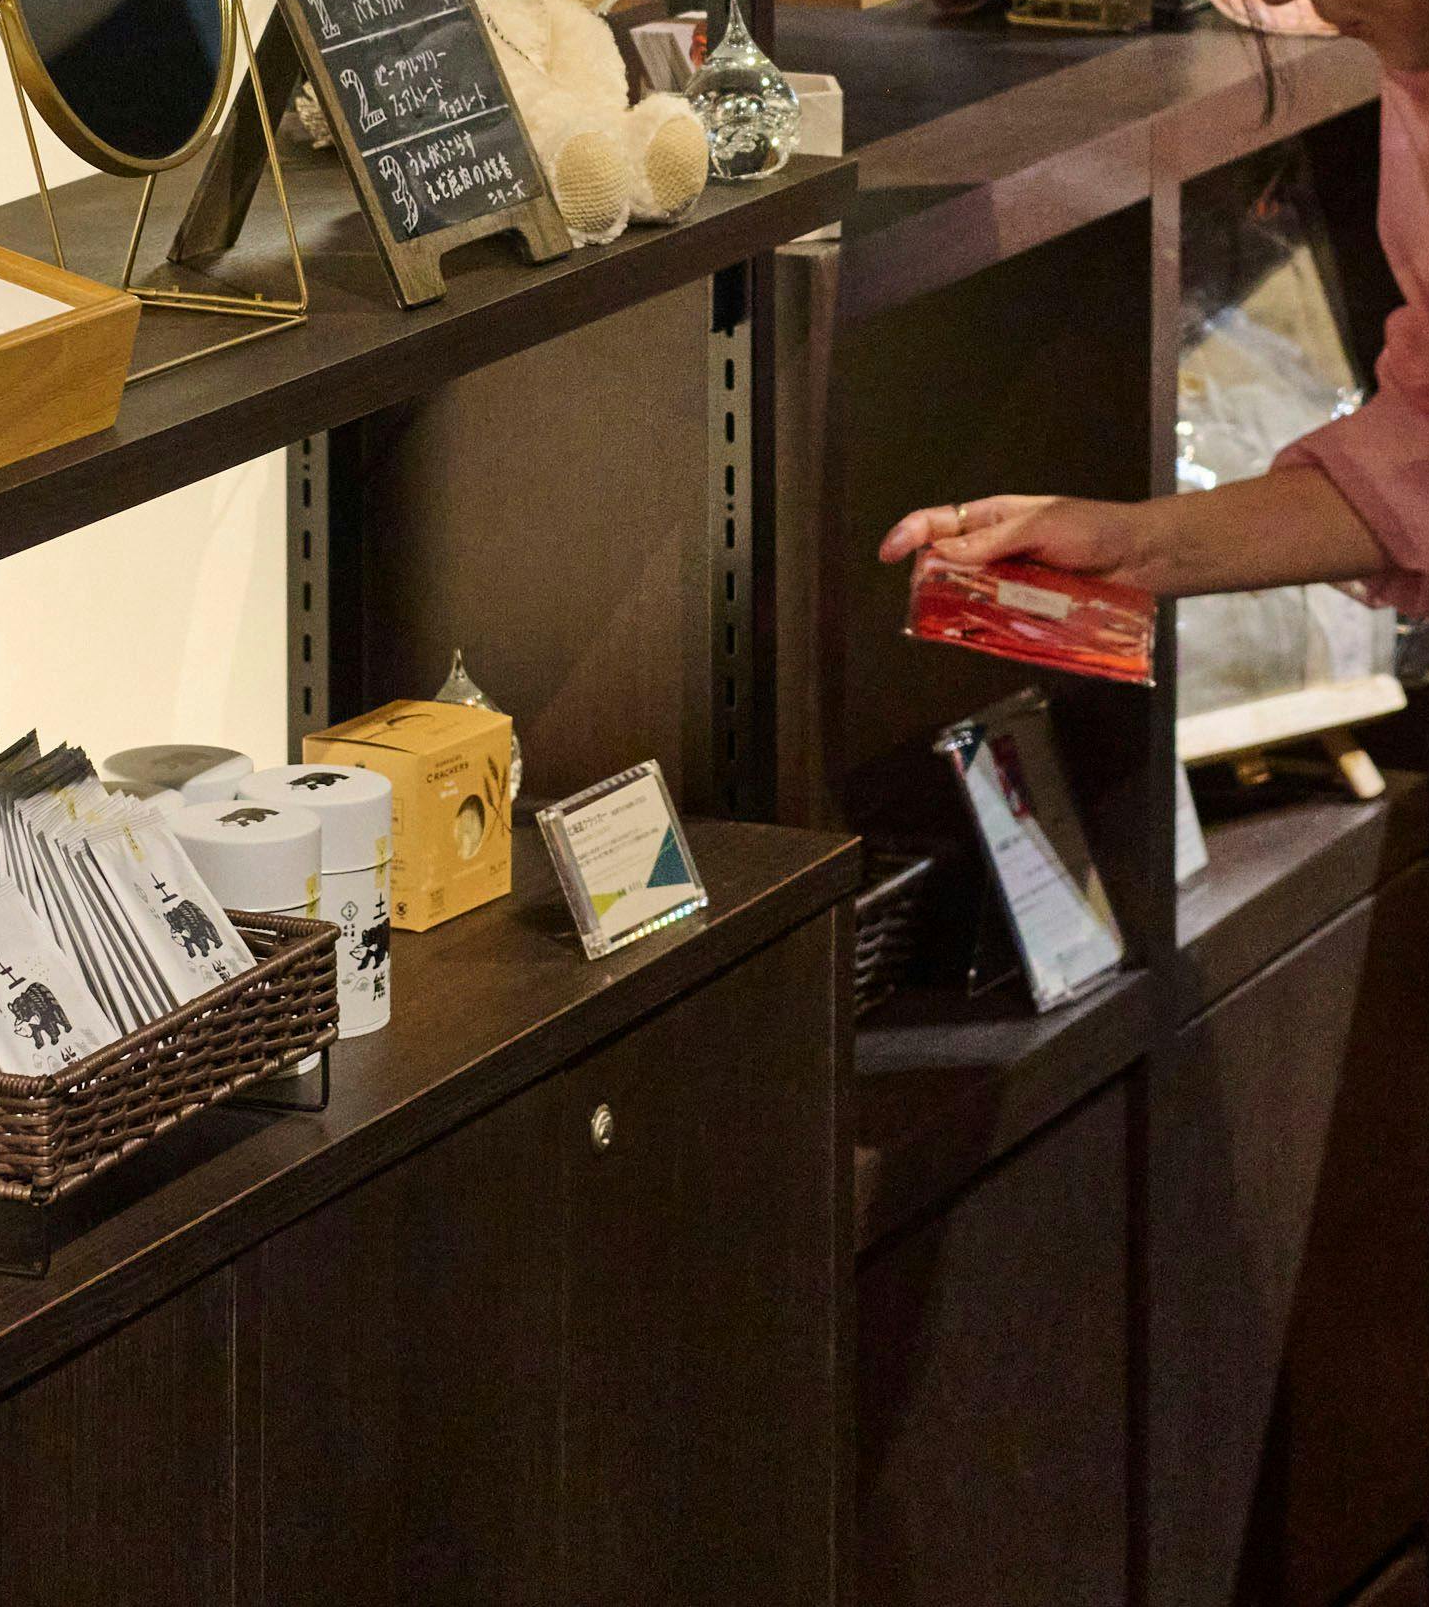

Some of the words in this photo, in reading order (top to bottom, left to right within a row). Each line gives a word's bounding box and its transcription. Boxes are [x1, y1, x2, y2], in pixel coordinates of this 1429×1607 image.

[340, 68, 388, 133] 2
[389, 77, 443, 117] フェアトレード
[438, 82, 487, 119] チョコレート
[487, 179, 528, 206] シリーズ
[426, 762, 470, 784] CRACKERS
